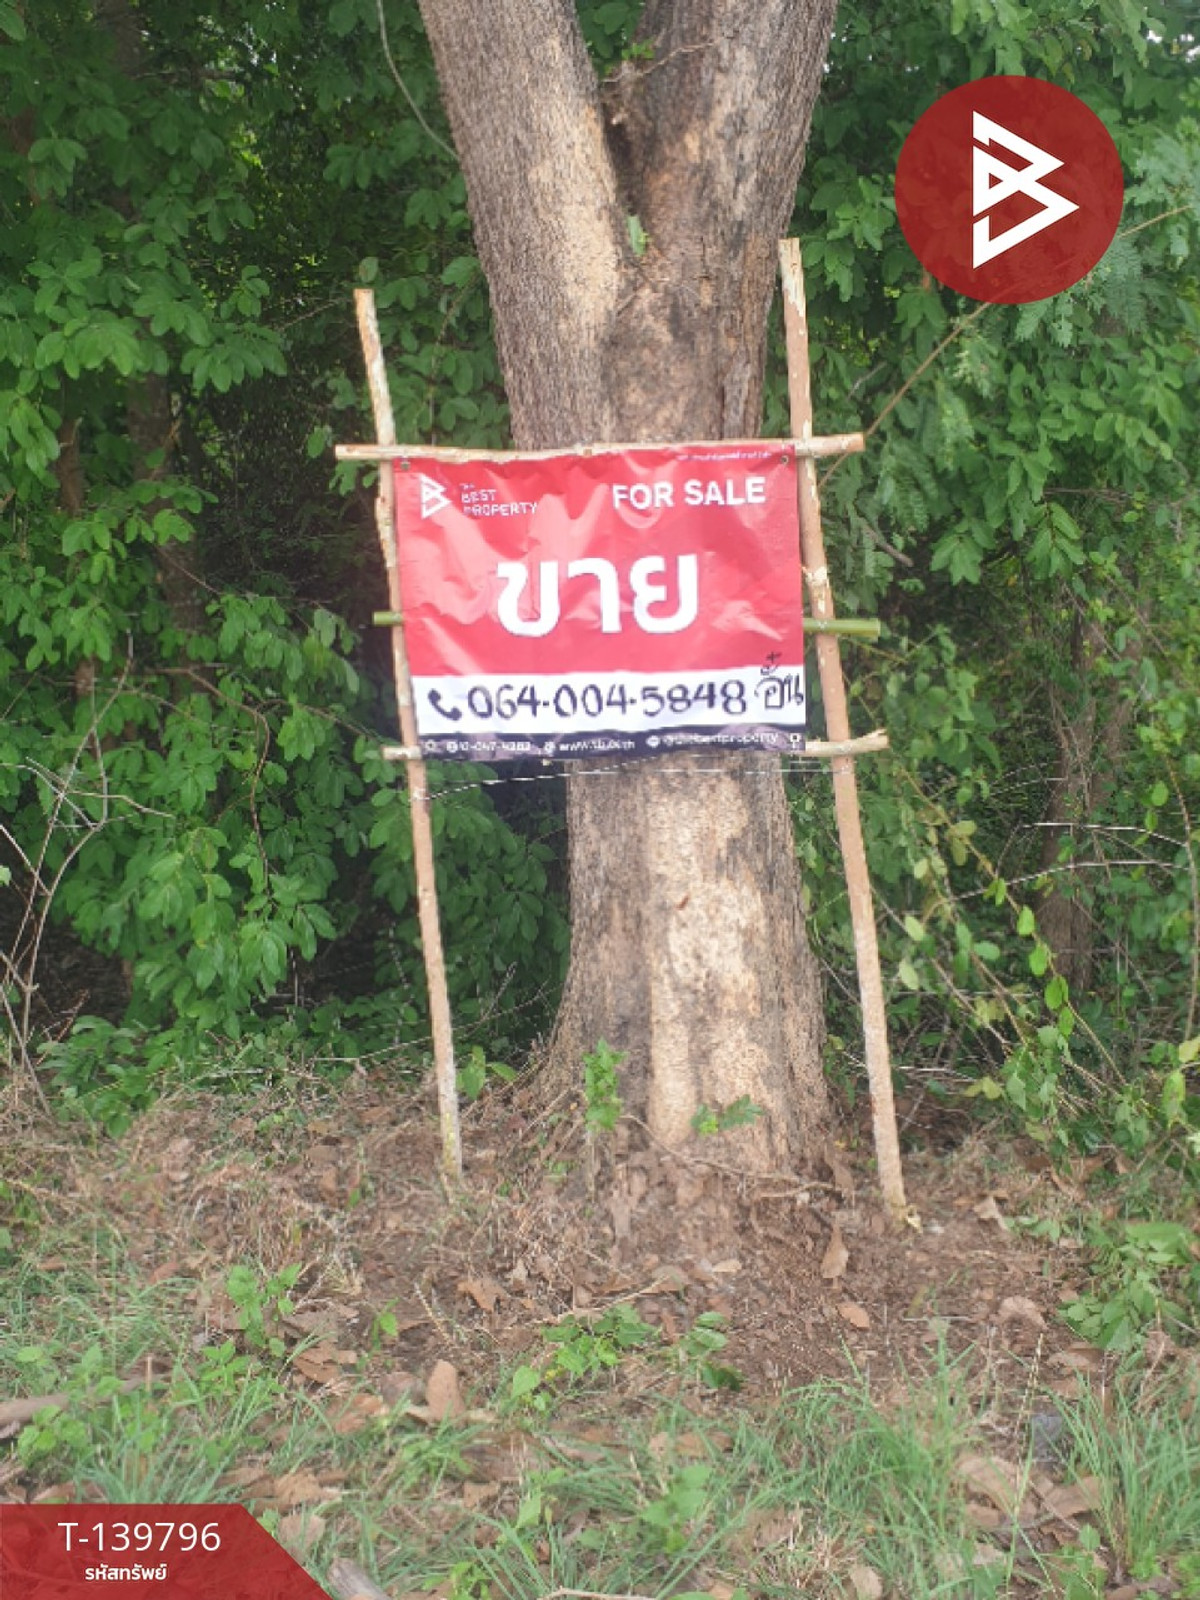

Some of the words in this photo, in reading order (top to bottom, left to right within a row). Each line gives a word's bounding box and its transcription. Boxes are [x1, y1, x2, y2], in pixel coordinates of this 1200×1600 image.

[461, 489, 496, 503] BEST
[612, 481, 674, 510] FOR
[684, 476, 766, 506] SALE
[463, 502, 537, 517] PROPERTY
[497, 554, 699, 637] ขาย
